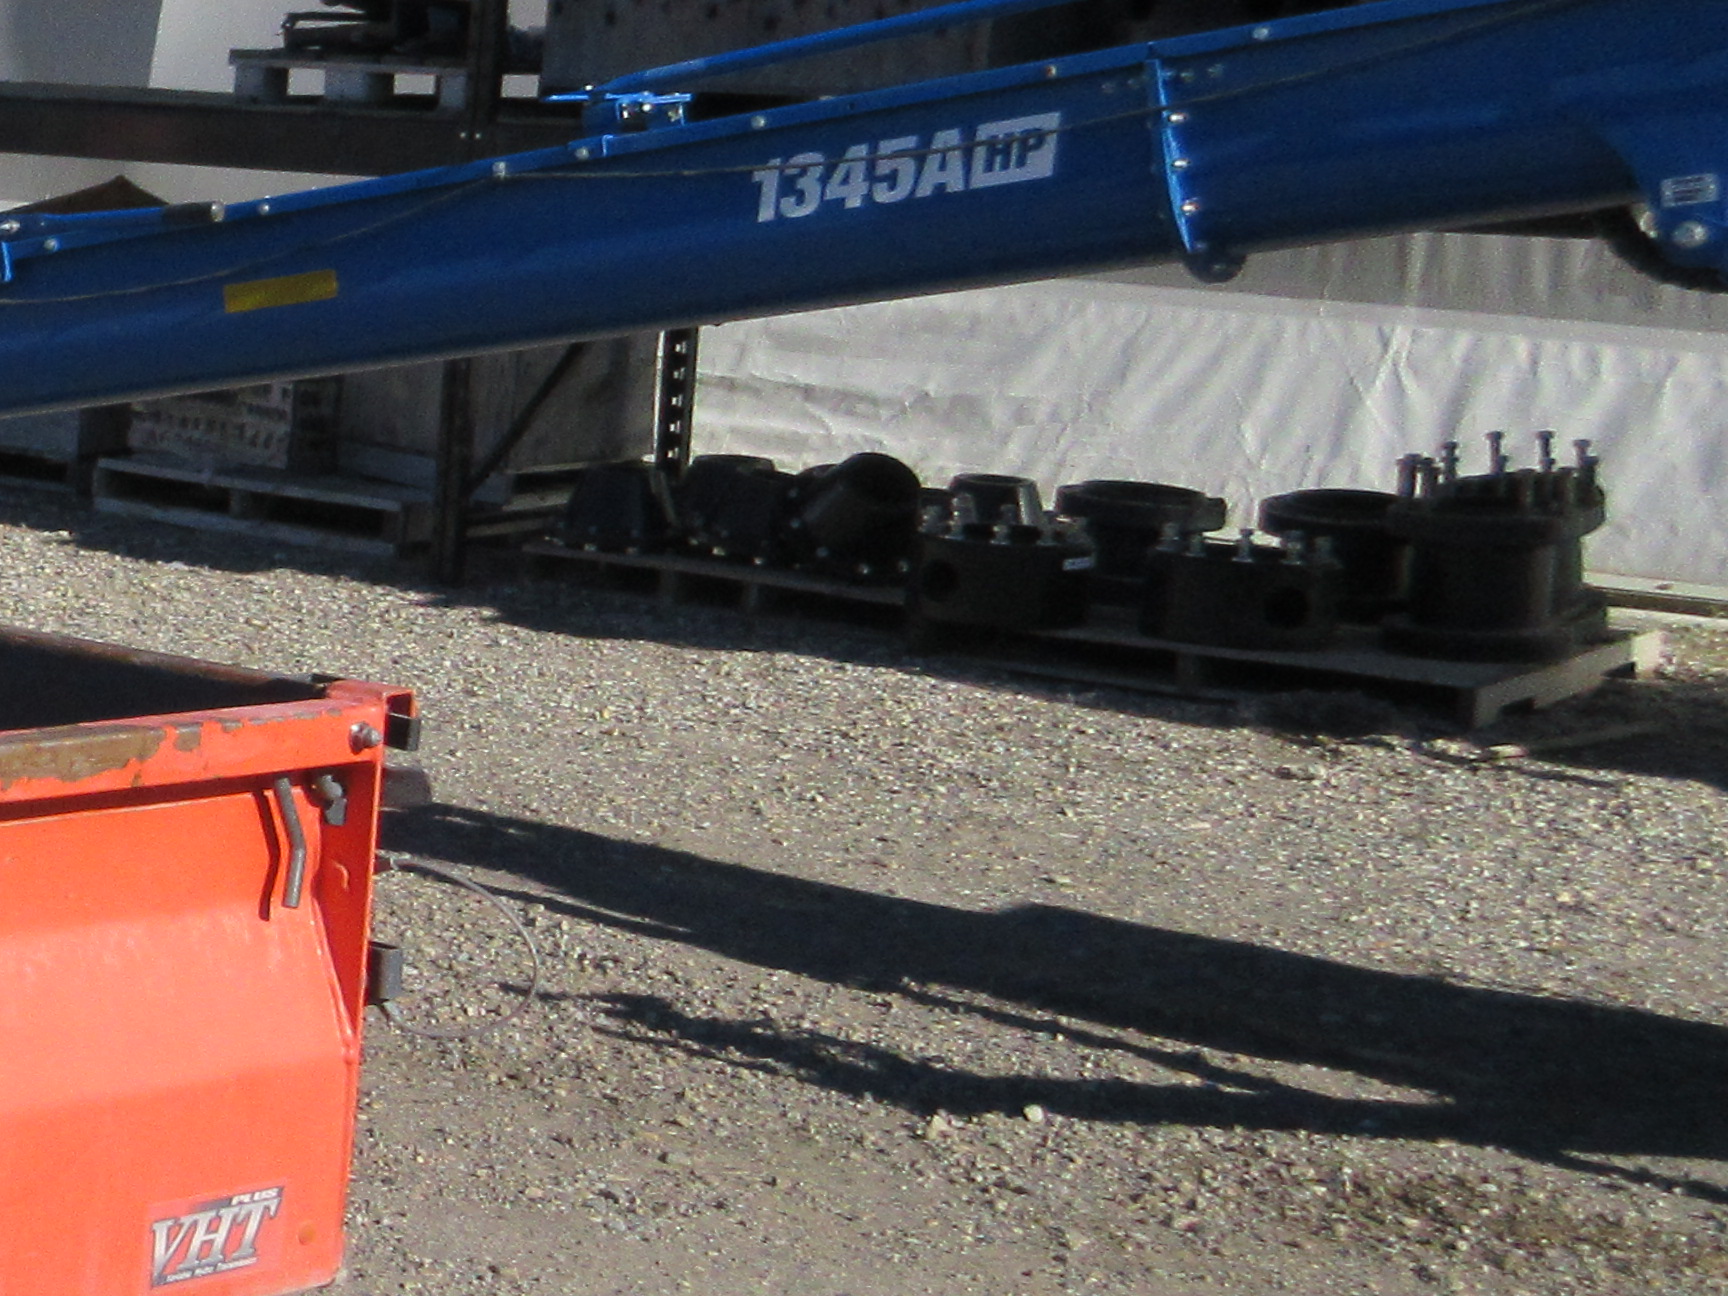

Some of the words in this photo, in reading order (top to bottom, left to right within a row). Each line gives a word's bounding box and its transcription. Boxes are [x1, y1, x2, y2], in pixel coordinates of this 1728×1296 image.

[751, 127, 966, 223] 1345A
[981, 127, 1045, 175] HP
[152, 1196, 282, 1285] VHT
